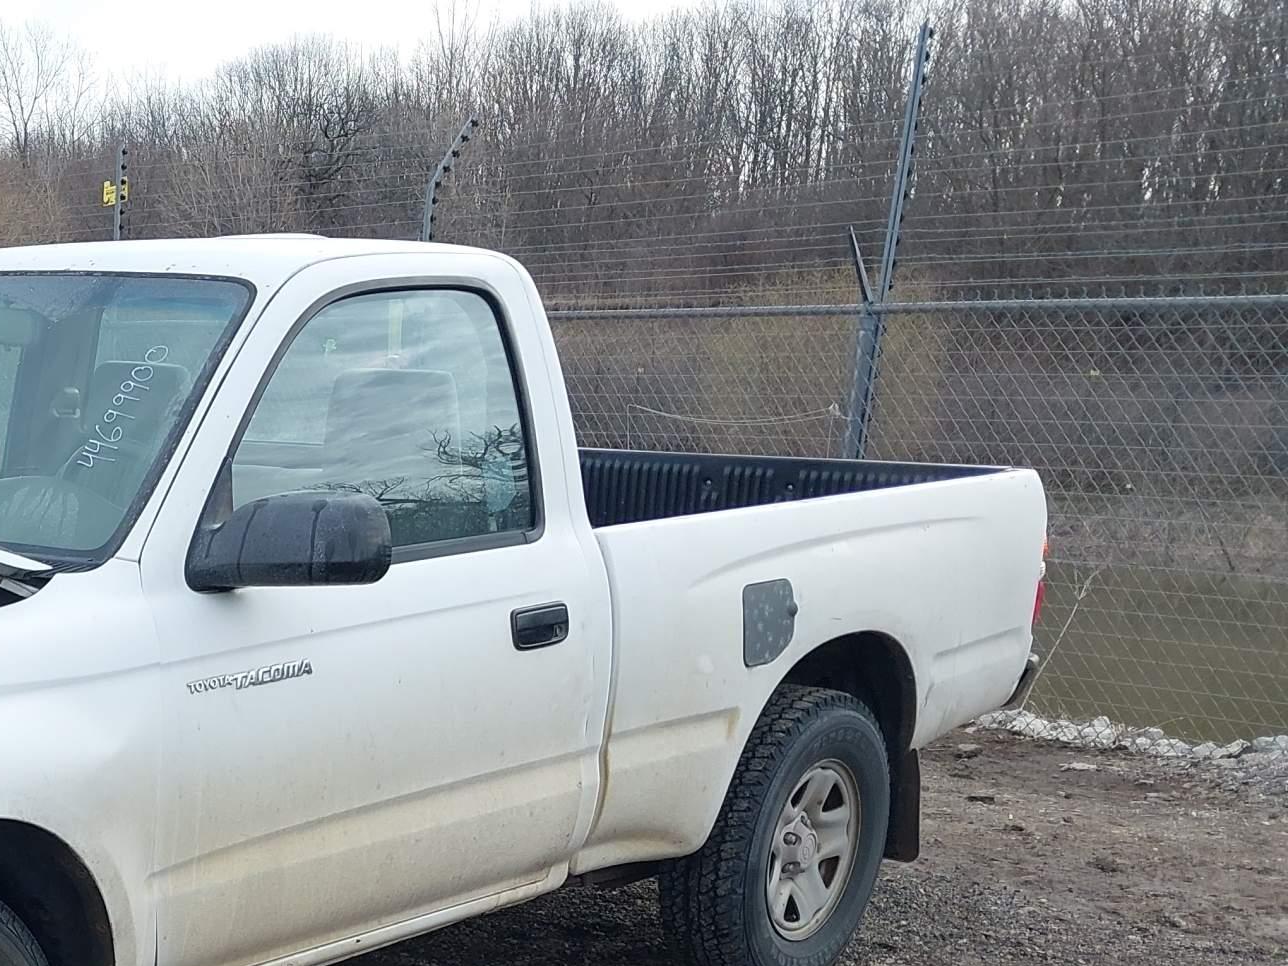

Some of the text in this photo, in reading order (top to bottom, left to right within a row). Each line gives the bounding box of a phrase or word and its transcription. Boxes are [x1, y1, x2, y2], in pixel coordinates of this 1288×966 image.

[76, 345, 169, 468] 44699900
[186, 658, 313, 694] TOYOTA TACOMA
